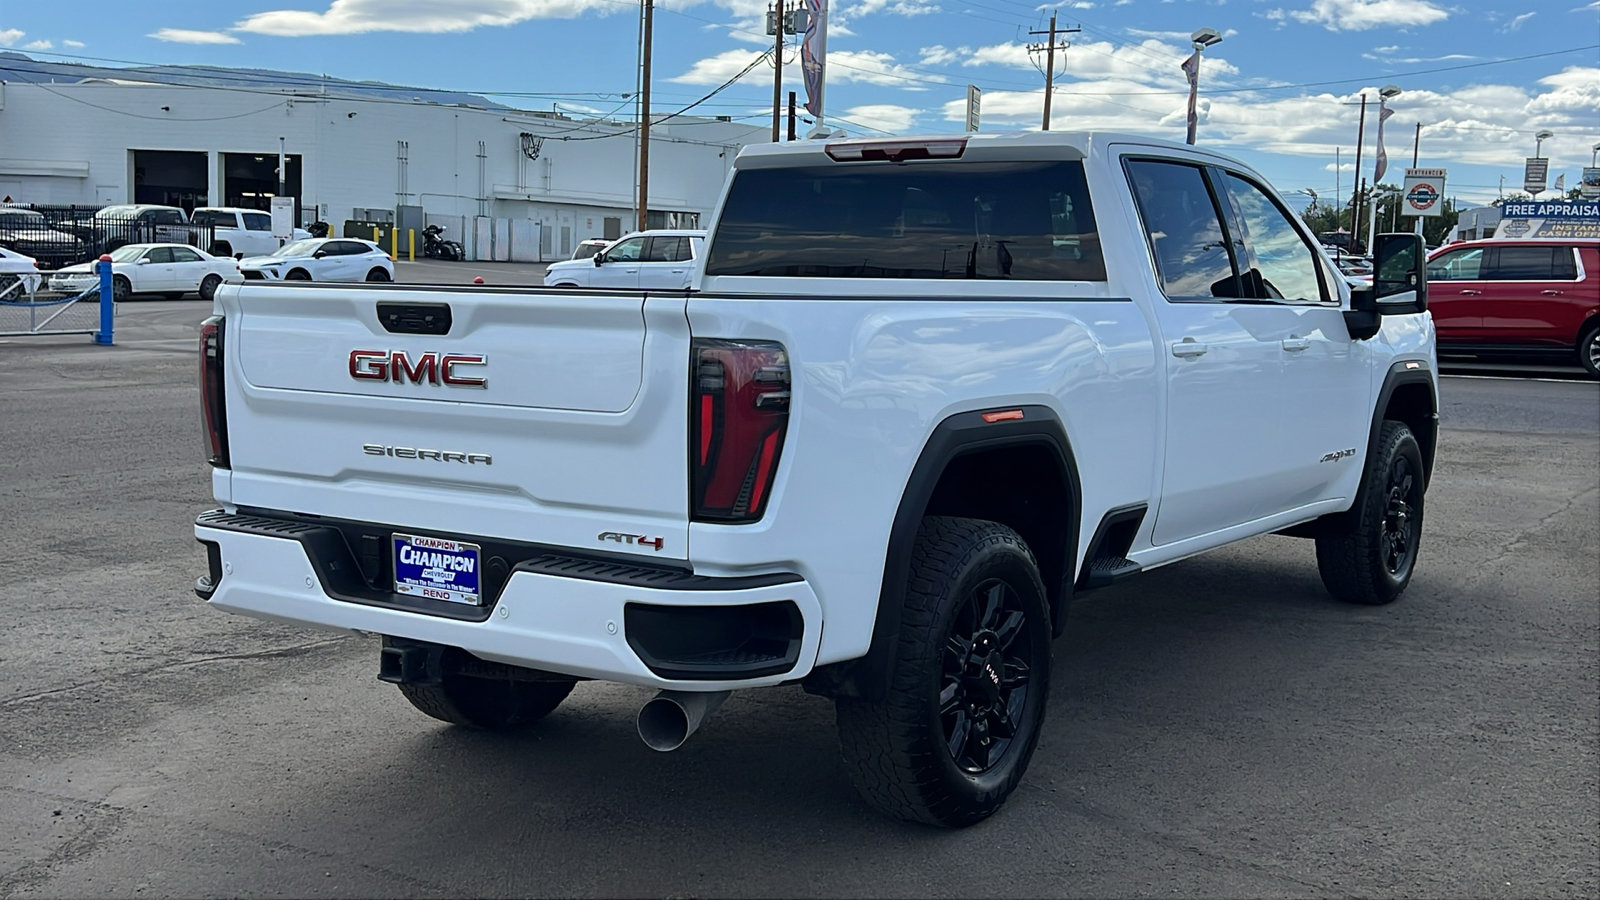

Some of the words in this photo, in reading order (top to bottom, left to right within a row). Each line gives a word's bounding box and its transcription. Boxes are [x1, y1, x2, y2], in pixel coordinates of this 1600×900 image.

[1505, 204, 1536, 215] FREE
[349, 350, 488, 390] GMC
[363, 443, 492, 466] SIERRA
[414, 537, 456, 550] CHAMPION
[598, 531, 664, 551] AT4
[400, 545, 474, 573] CHAMPION
[424, 570, 453, 579] CHEVROLET
[423, 589, 451, 599] RENO
